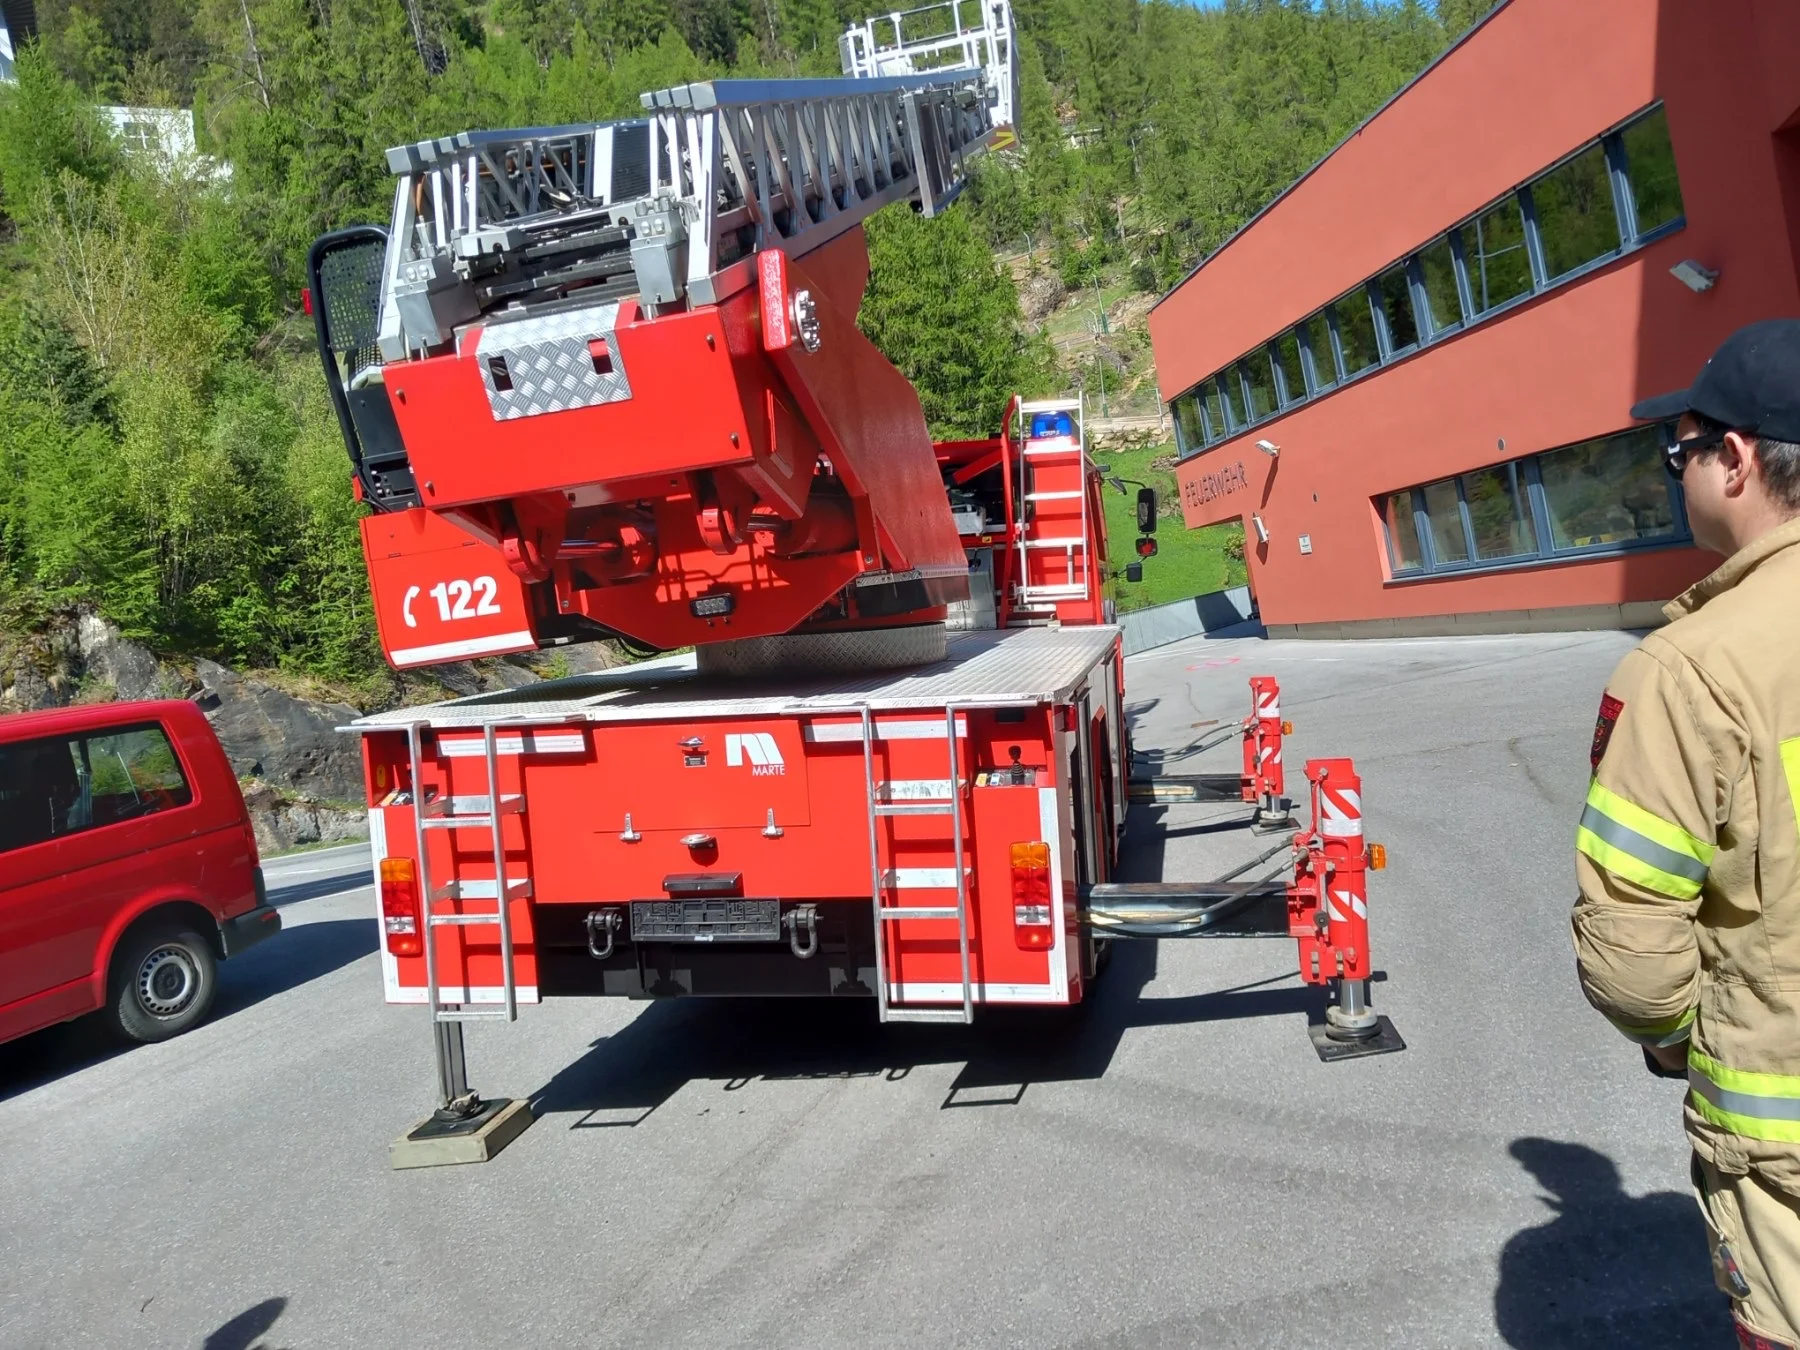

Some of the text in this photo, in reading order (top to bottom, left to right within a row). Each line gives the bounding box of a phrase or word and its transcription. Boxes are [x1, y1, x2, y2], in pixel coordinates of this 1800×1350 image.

[1184, 461, 1249, 508] FEUERWEHR
[429, 575, 502, 622] 122
[752, 764, 786, 776] MARTE
